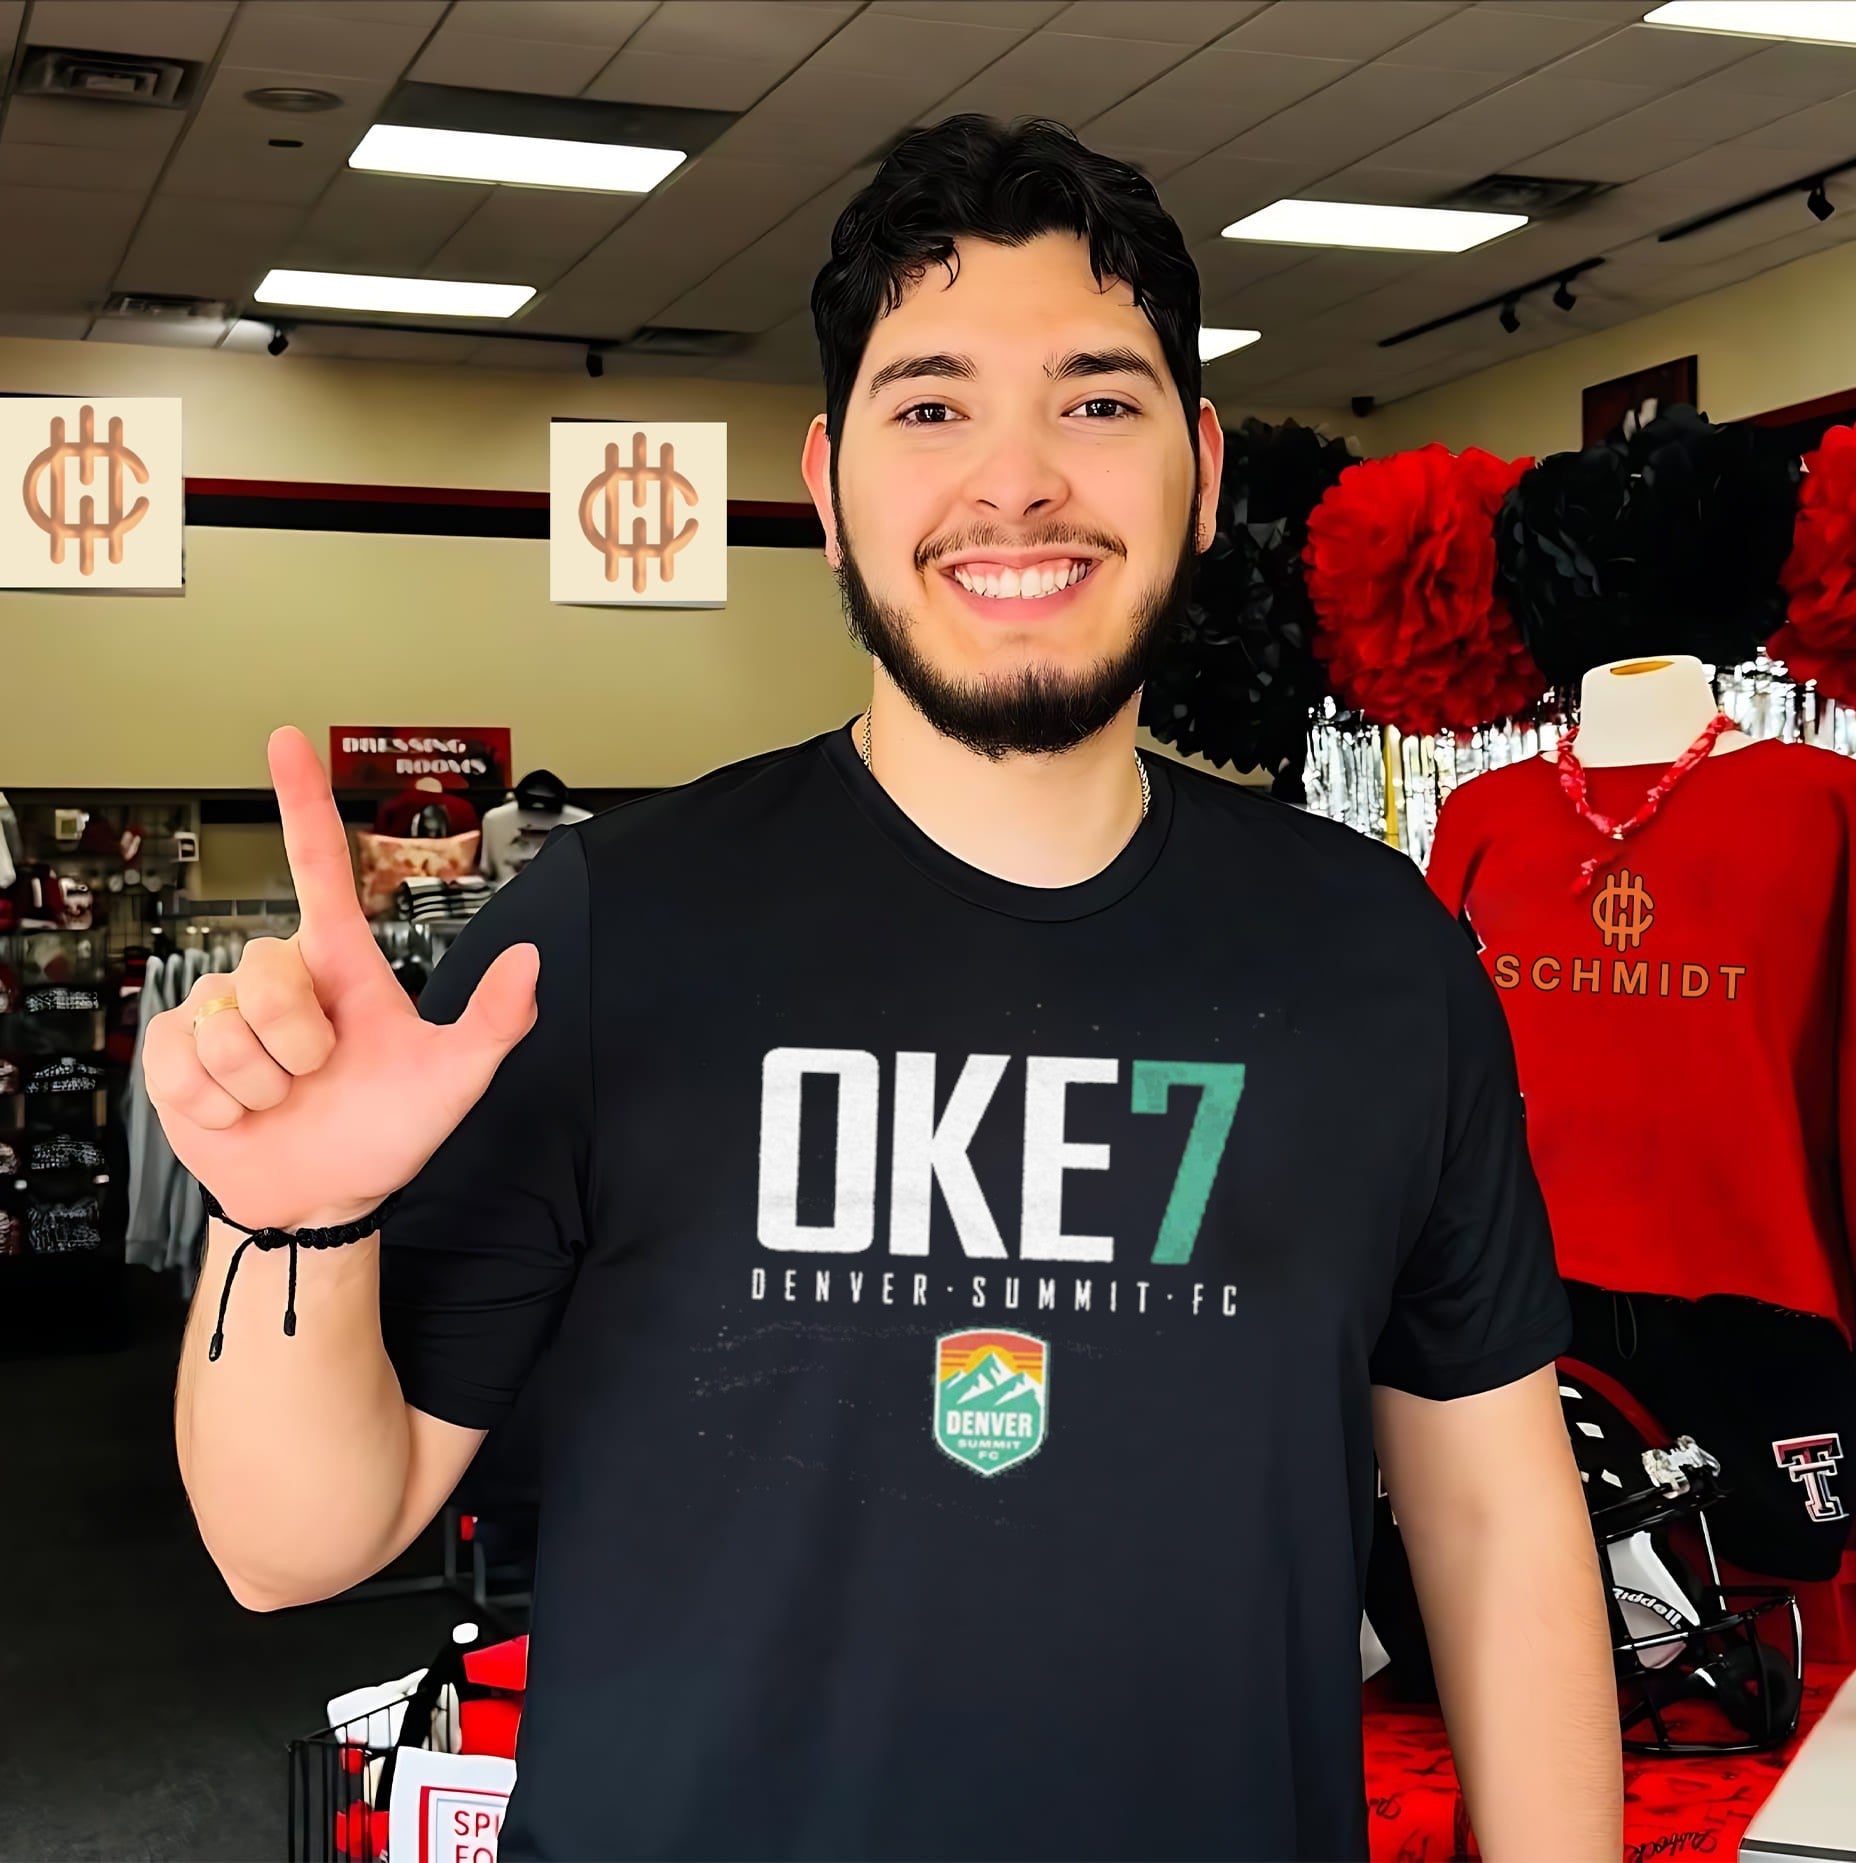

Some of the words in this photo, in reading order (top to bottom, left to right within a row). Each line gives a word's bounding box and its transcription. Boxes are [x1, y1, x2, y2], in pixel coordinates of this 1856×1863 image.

[342, 737, 467, 754] DRESSING
[396, 758, 487, 775] ROOMS
[1494, 954, 1747, 1001] SCHMIDT
[757, 1047, 1246, 1265] OKE7
[946, 1410, 1033, 1438] DENVER
[957, 1439, 1021, 1450] SUMMIT
[978, 1450, 999, 1461] FC
